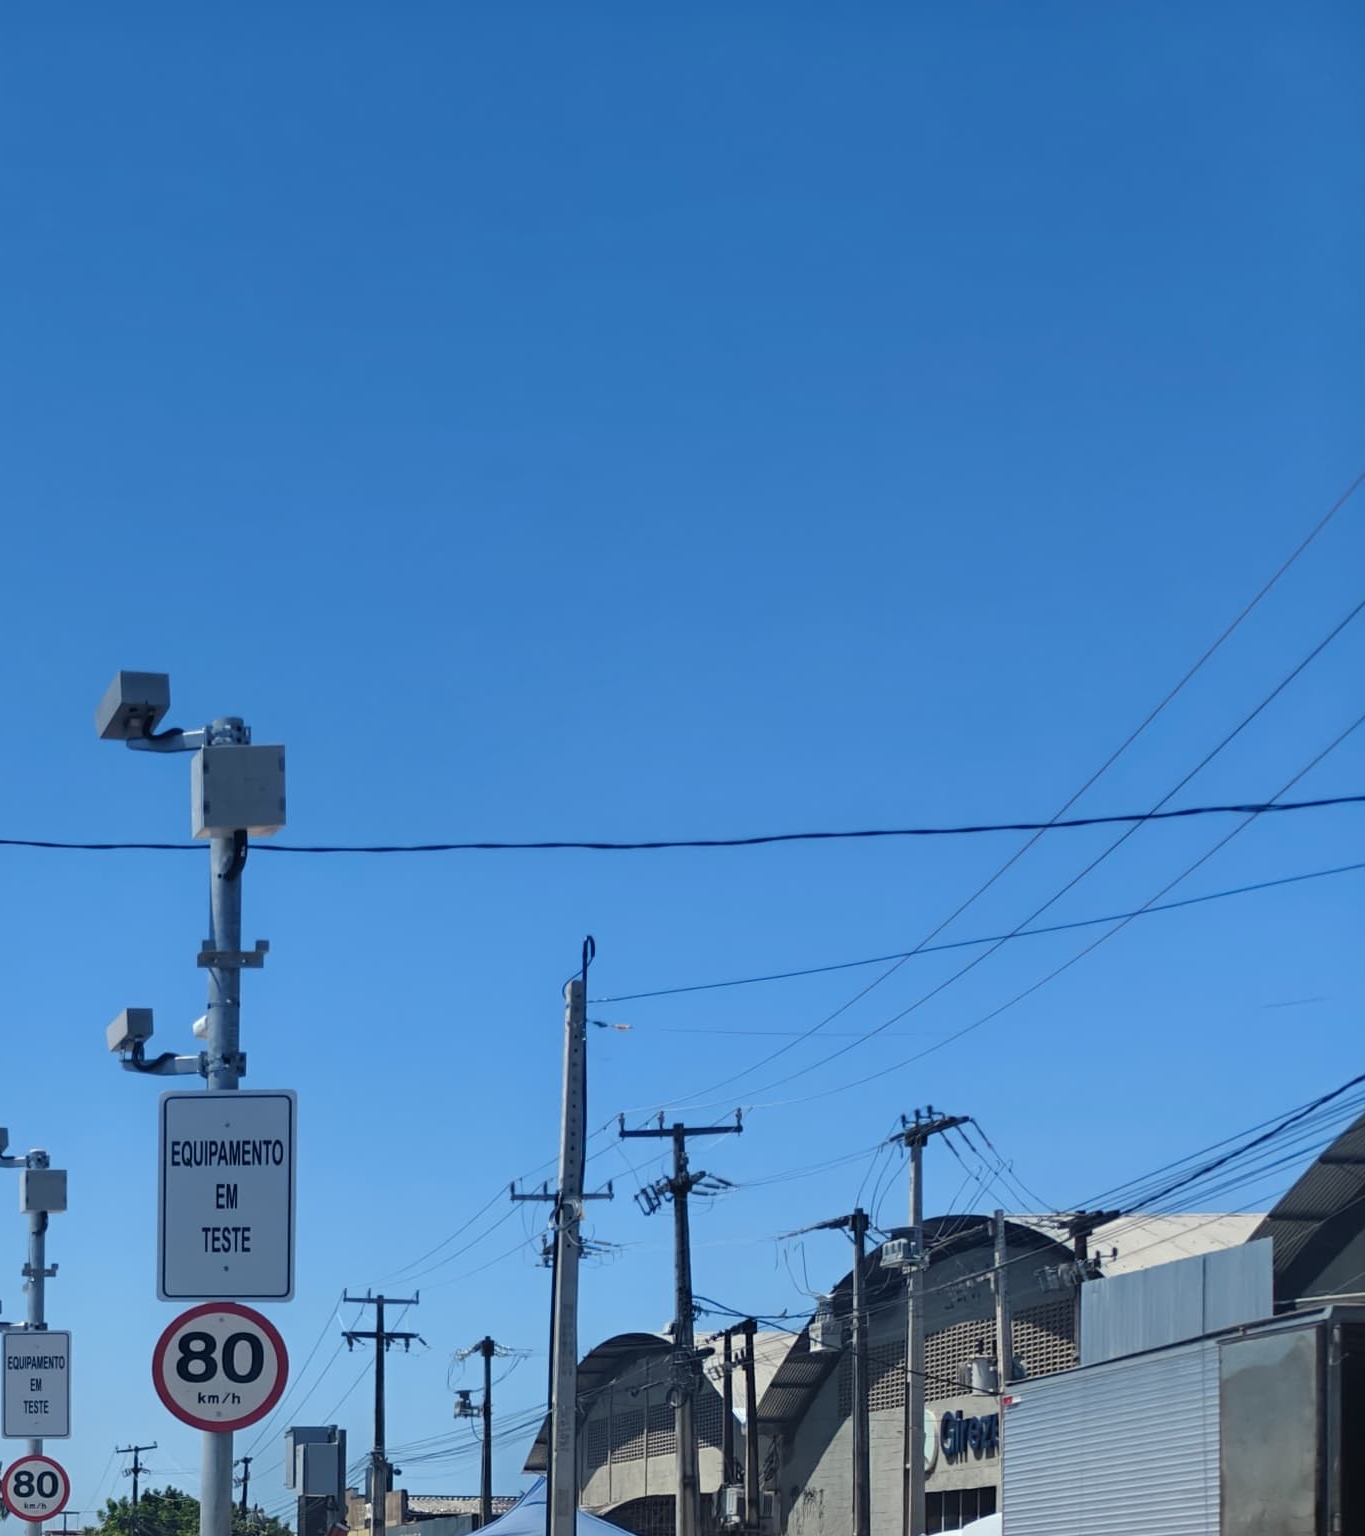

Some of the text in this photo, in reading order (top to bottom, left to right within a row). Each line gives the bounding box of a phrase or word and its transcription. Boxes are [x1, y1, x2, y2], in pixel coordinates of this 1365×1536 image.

[171, 1139, 284, 1168] EQUIPAMENTO
[216, 1183, 238, 1209] EM
[201, 1226, 251, 1253] TESTE
[7, 1355, 66, 1370] EQUIPAMENTO
[176, 1331, 265, 1384] 80
[30, 1378, 42, 1392] EM
[23, 1400, 49, 1414] TESTE
[197, 1392, 241, 1405] km/h
[13, 1470, 59, 1498] 80
[24, 1501, 47, 1510] km/h
